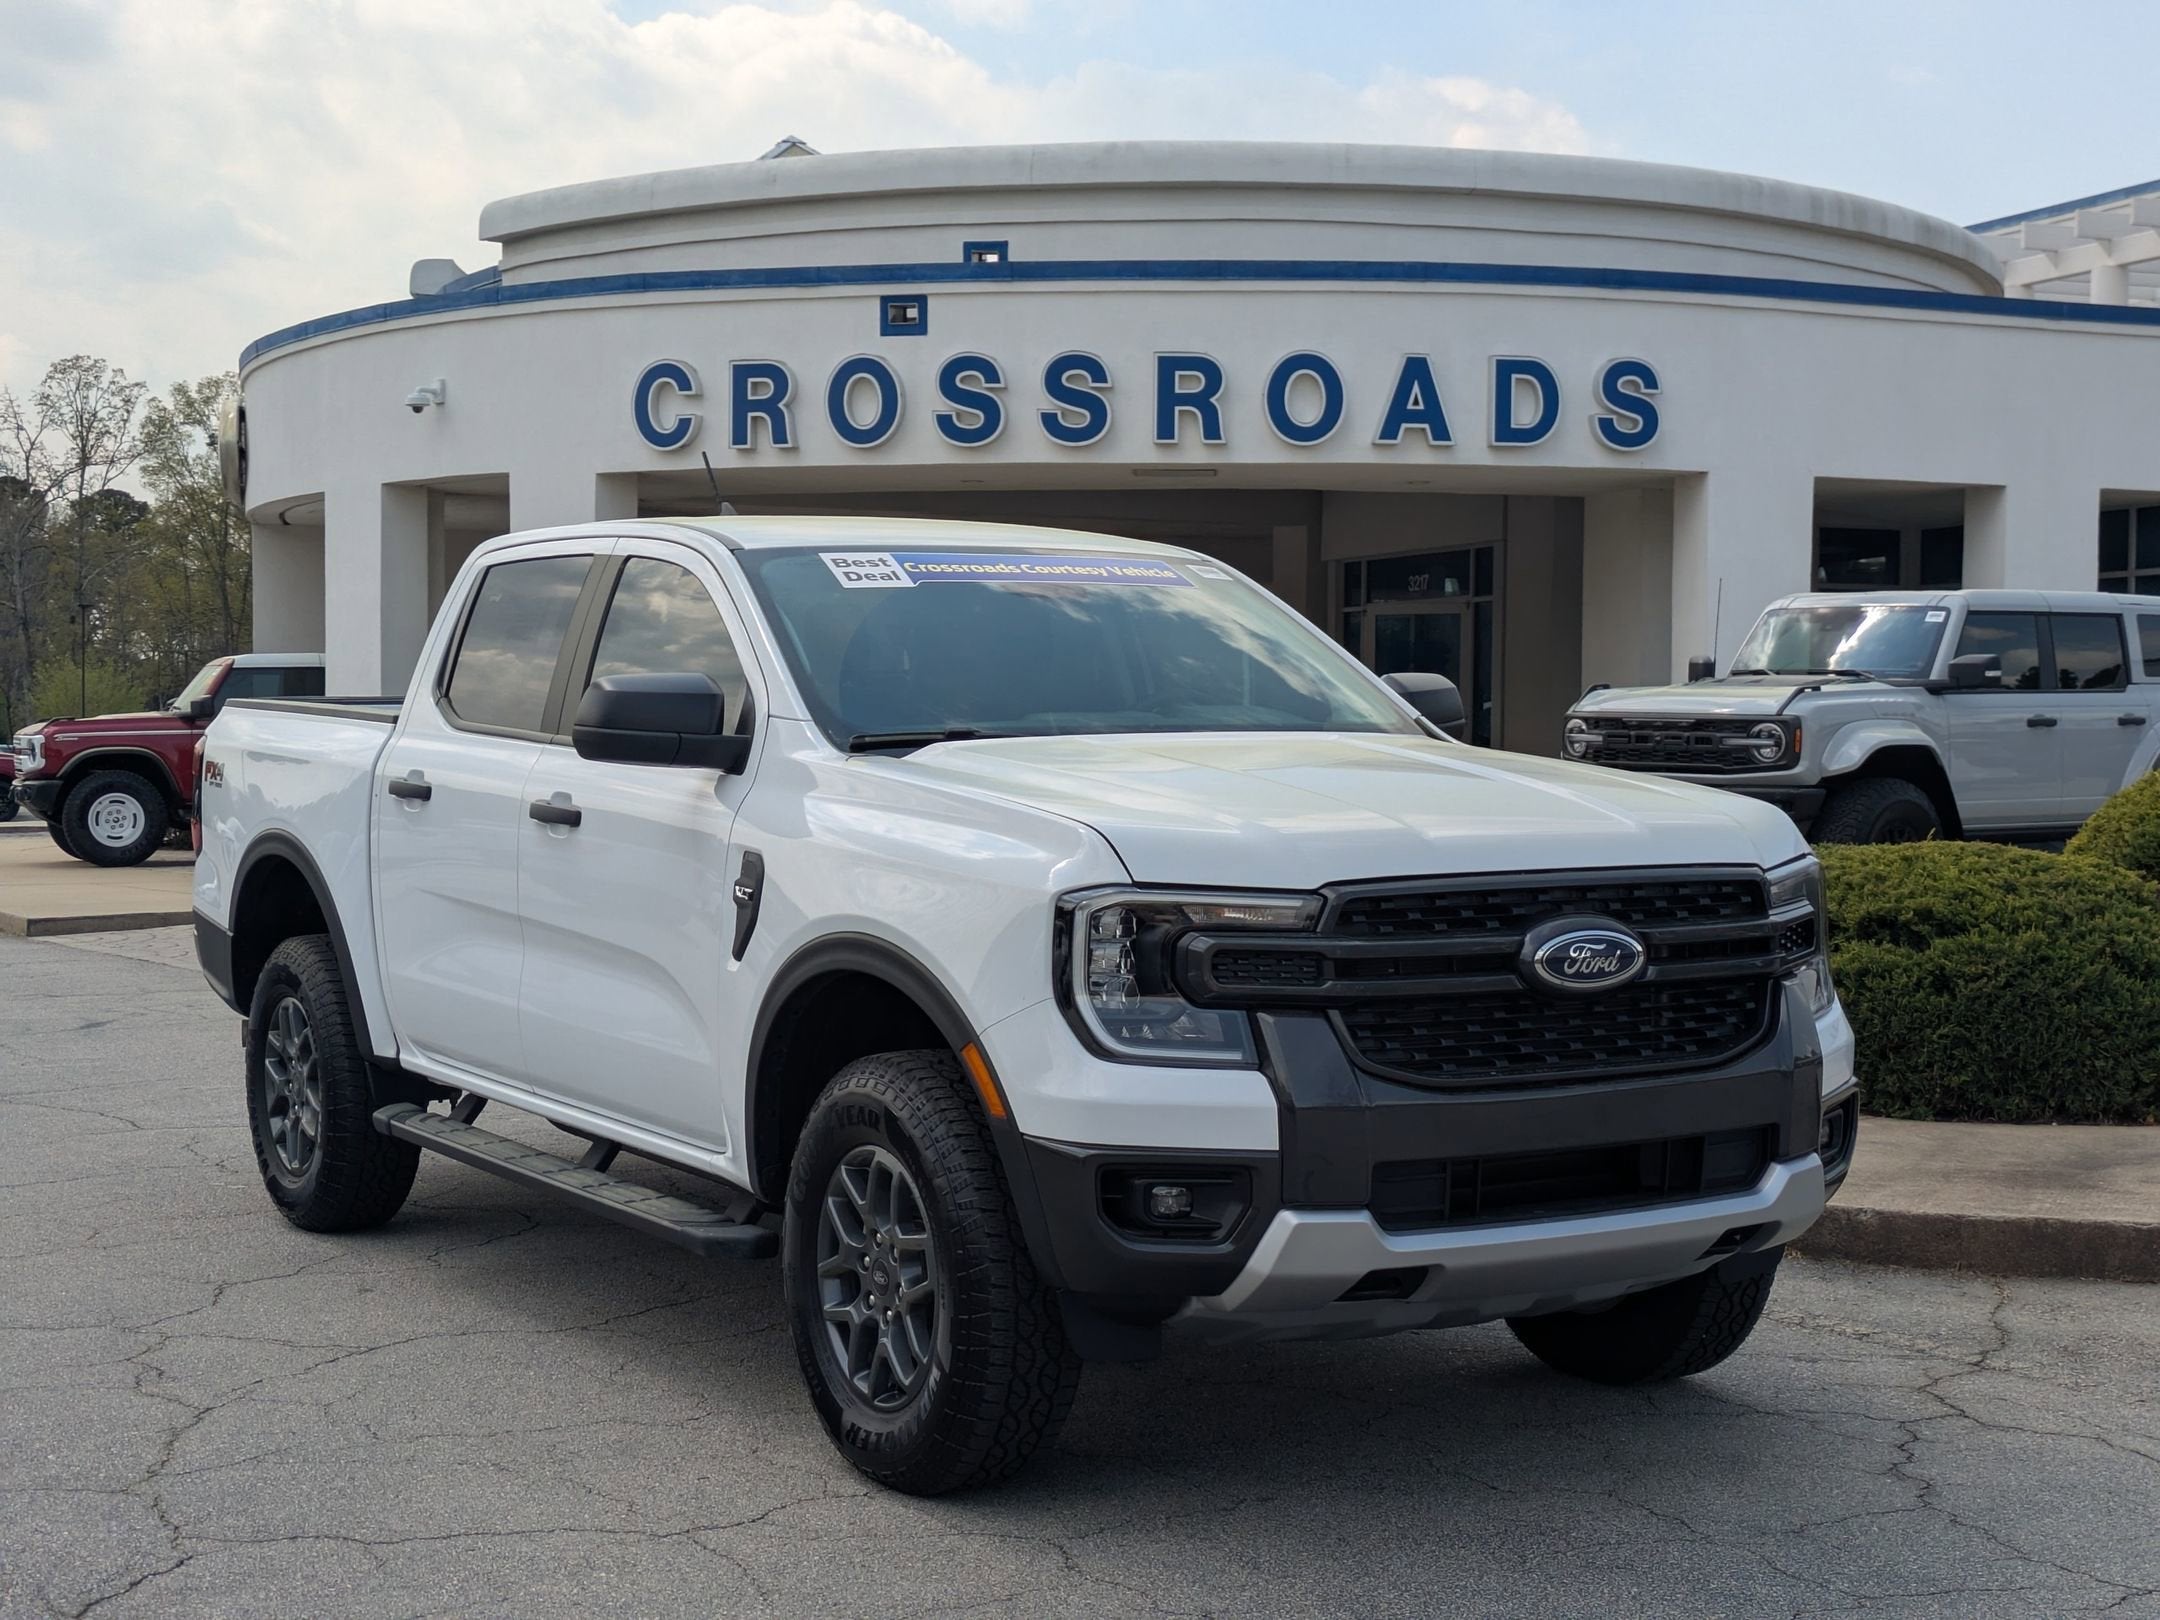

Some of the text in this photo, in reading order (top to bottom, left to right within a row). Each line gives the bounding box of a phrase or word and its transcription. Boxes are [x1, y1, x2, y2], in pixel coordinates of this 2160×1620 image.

[631, 350, 1663, 452] CROSSROADS
[830, 556, 892, 569] Best
[903, 561, 1022, 575] Crossroads
[1024, 563, 1108, 578] Courtesy
[1110, 565, 1179, 579] Vehicle
[846, 569, 902, 583] Deal
[1407, 574, 1430, 592] 3217
[204, 760, 226, 783] FX4
[1563, 943, 1622, 975] Ford
